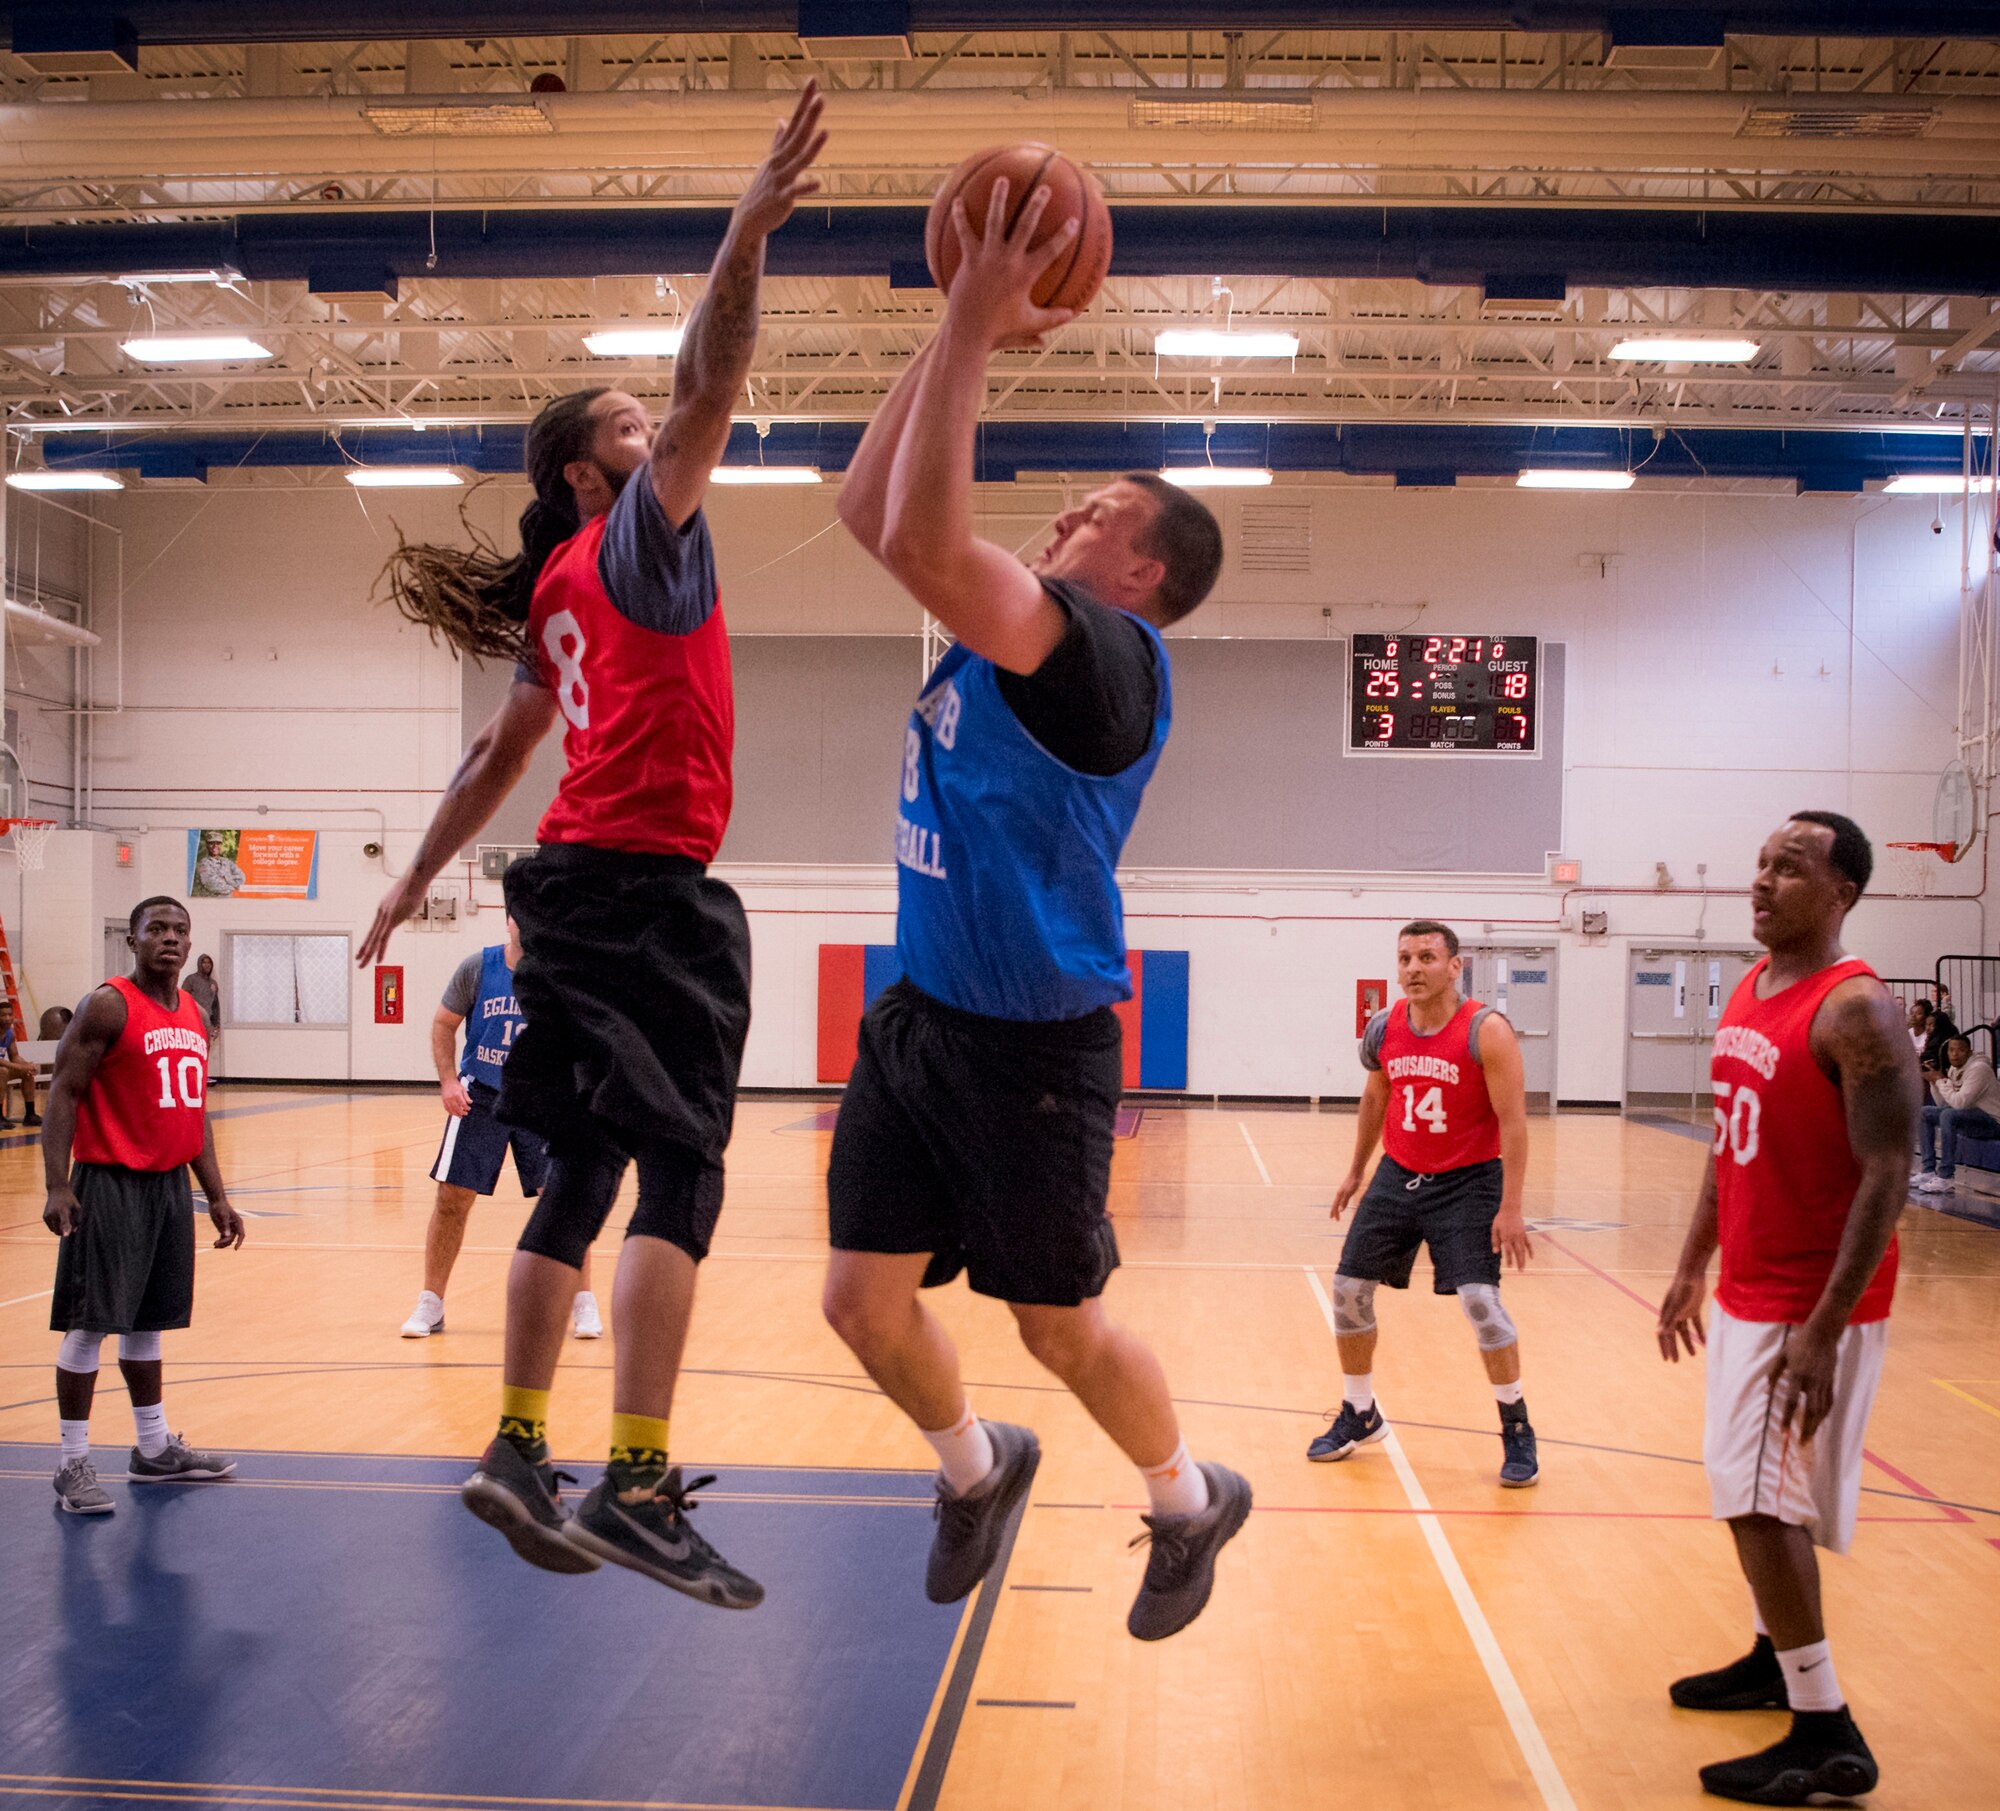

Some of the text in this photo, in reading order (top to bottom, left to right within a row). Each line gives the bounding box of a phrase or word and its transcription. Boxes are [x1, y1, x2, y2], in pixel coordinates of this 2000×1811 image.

[1386, 642, 1398, 658] 0
[1424, 637, 1482, 663] 2:21
[1492, 643, 1504, 658] 0
[542, 609, 589, 731] 8
[1363, 659, 1399, 670] HOME
[1487, 661, 1528, 672] GUEST
[1366, 671, 1399, 697] 25
[1432, 691, 1456, 699] BONUS
[1503, 673, 1528, 698] 18
[1378, 714, 1394, 739] 3
[1512, 716, 1526, 739] 7
[1497, 742, 1521, 750] POINTS
[144, 1027, 208, 1061] CRUSADERS
[476, 1045, 510, 1066] BASK
[157, 1056, 204, 1108] 10
[1387, 1055, 1460, 1085] CRUSADERS
[1402, 1084, 1448, 1133] 14
[1711, 1080, 1761, 1166] 50
